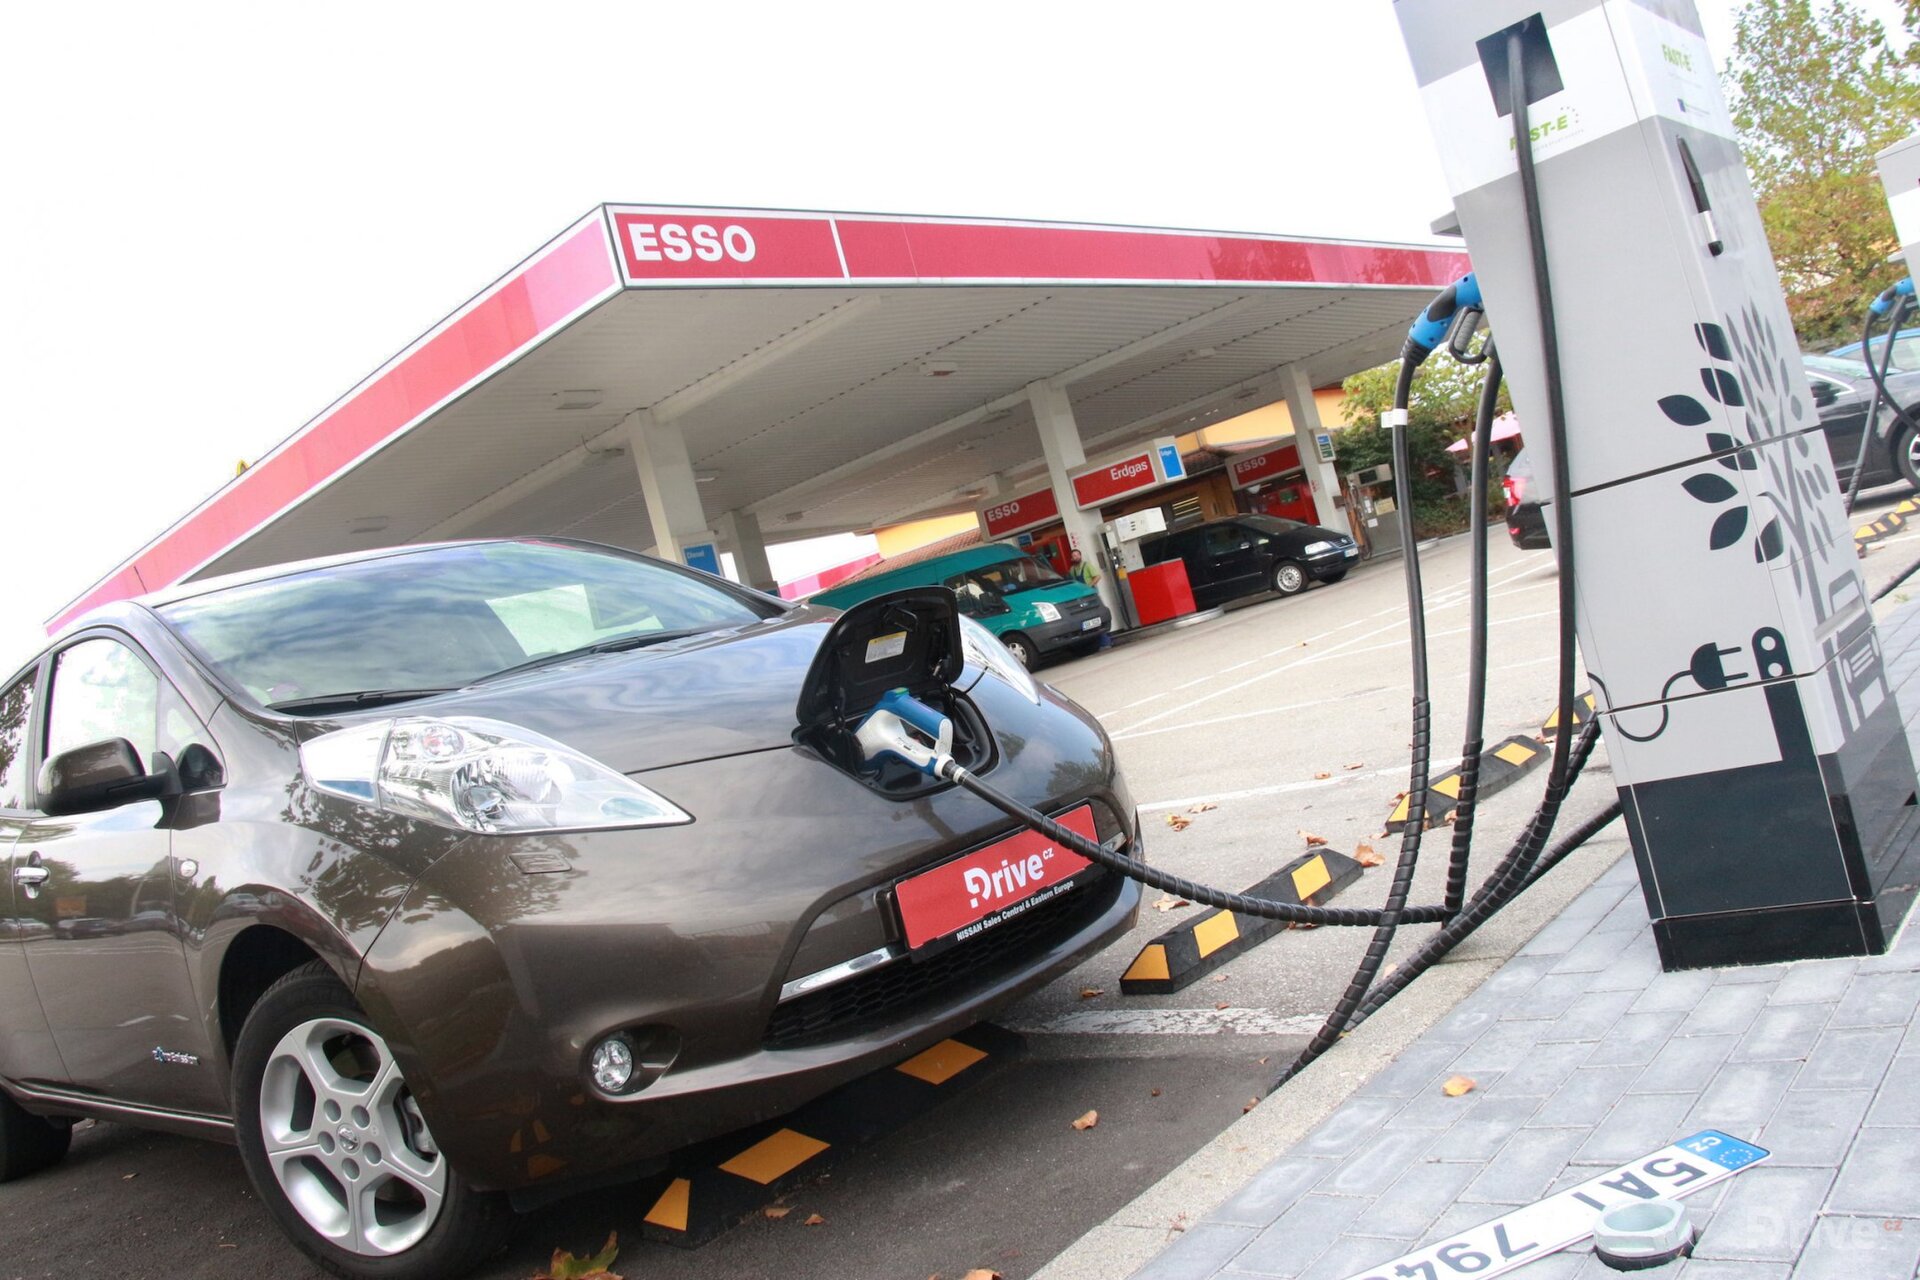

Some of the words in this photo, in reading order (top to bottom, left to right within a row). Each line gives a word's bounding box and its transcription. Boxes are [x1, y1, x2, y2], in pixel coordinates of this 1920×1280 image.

[1509, 115, 1568, 151] FST-E
[627, 223, 756, 262] ESSO
[1110, 461, 1148, 480] Erdgas
[1236, 456, 1266, 473] ESSO
[987, 502, 1019, 522] ESSO
[963, 854, 1044, 909] Drive
[956, 922, 983, 941] NISSAN
[983, 914, 1002, 929] Sales
[1001, 902, 1026, 920] Central
[1025, 900, 1031, 909] &
[1030, 889, 1054, 906] Eastern
[1053, 880, 1074, 895] Europe
[1686, 1135, 1722, 1153] CZ
[1363, 1222, 1539, 1280] 794
